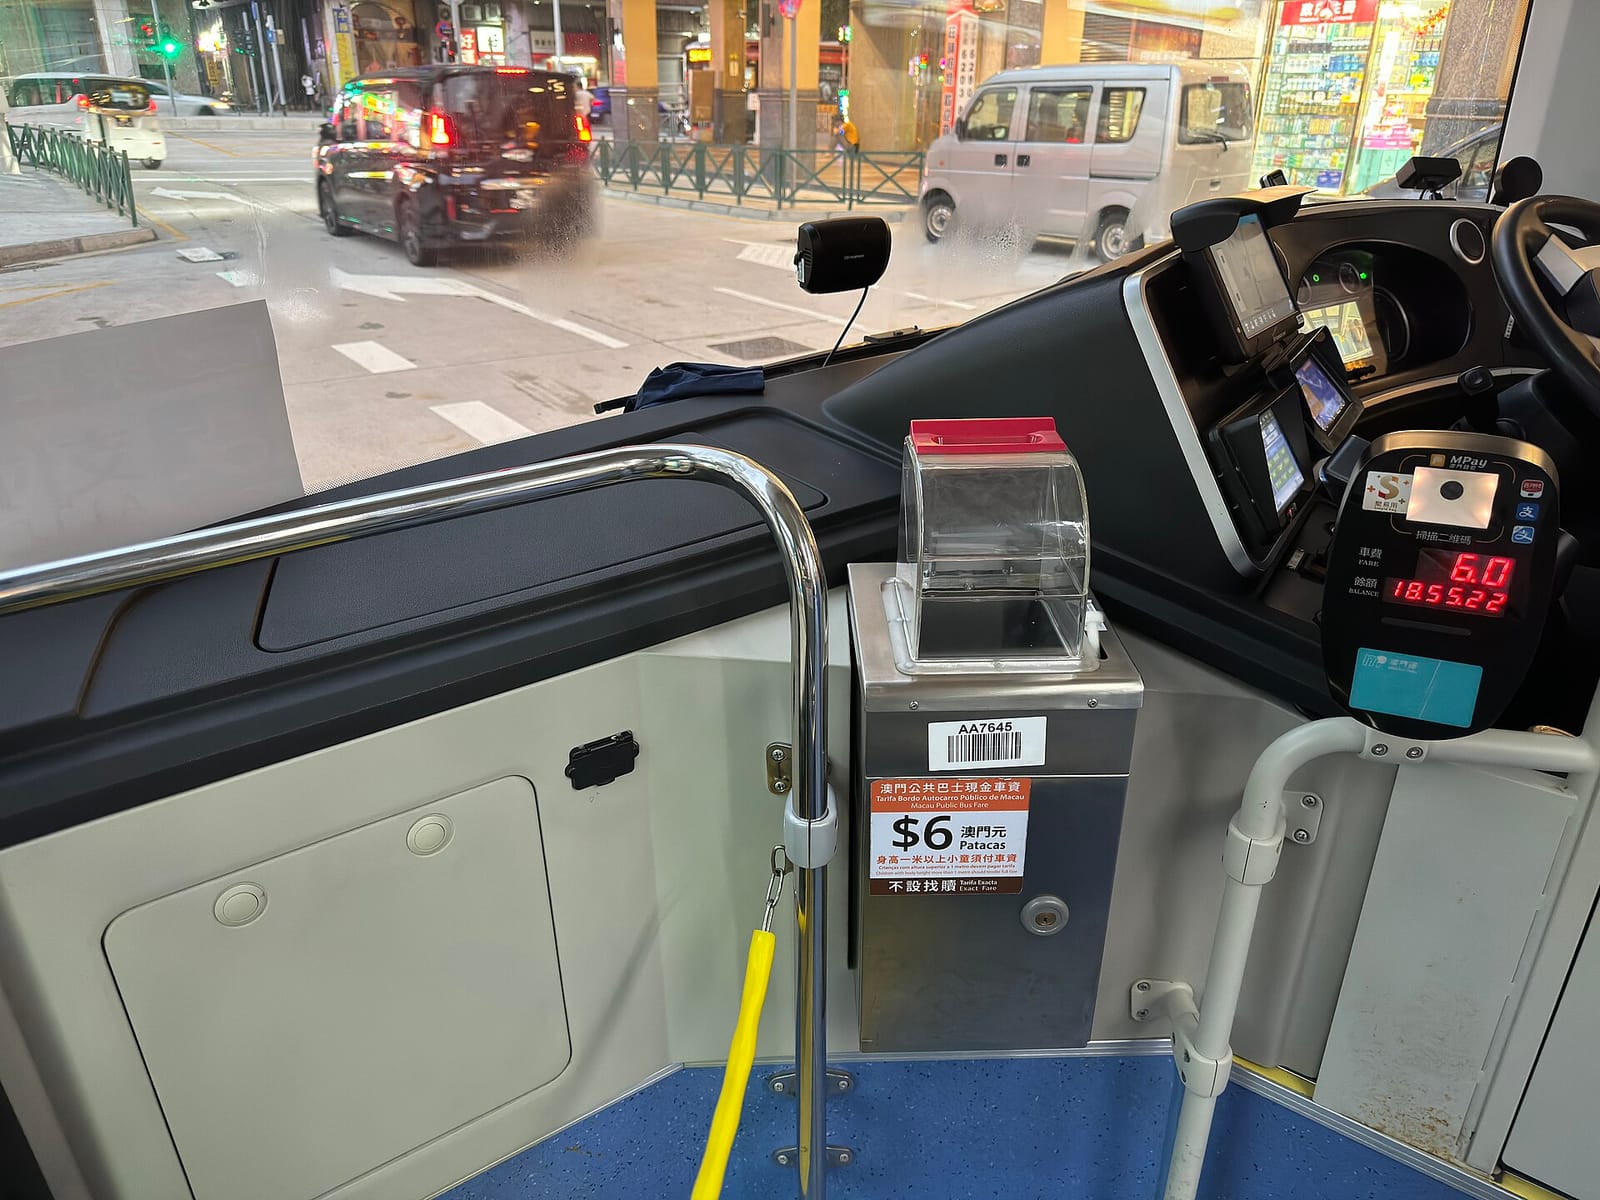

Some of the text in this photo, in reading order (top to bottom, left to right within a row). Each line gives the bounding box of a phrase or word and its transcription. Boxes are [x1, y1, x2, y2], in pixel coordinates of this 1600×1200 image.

[1450, 455, 1488, 469] MPay
[1416, 530, 1472, 545] 掃描二維碼
[1358, 547, 1382, 559] 車費
[1358, 559, 1379, 567] FARE
[1450, 552, 1513, 587] 6.0
[1354, 576, 1378, 589] 餘額
[1349, 588, 1379, 597] BALANCE
[958, 721, 1013, 734] AA7645
[880, 781, 1021, 794] 澳門公共巴士現金車資
[960, 793, 988, 801] Público
[892, 815, 953, 852] $6
[960, 825, 1006, 838] 澳門元
[959, 840, 1006, 850] Patacas
[876, 854, 1017, 865] 身高一米以上小童須付車資
[888, 879, 957, 893] 不設找贖
